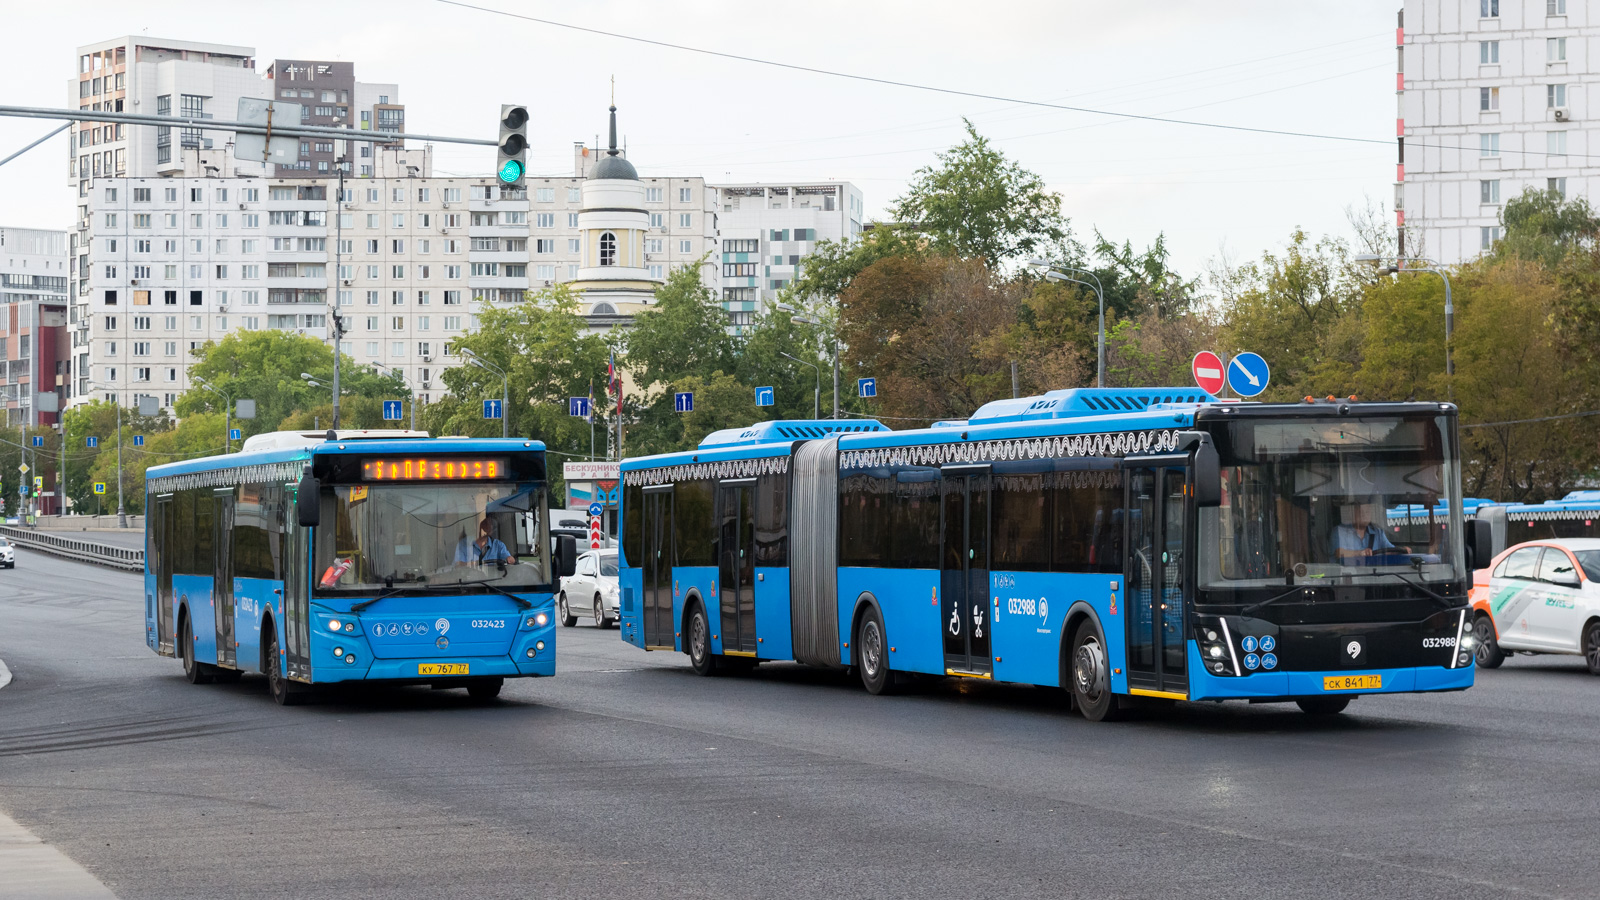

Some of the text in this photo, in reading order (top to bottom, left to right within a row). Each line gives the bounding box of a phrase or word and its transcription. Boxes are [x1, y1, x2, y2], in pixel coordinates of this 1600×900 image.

[1008, 598, 1036, 615] 032988
[472, 620, 505, 628] 032423
[1423, 637, 1456, 648] 032988
[437, 664, 453, 674] 767
[1345, 677, 1363, 688] 841
[1369, 675, 1378, 684] 77
